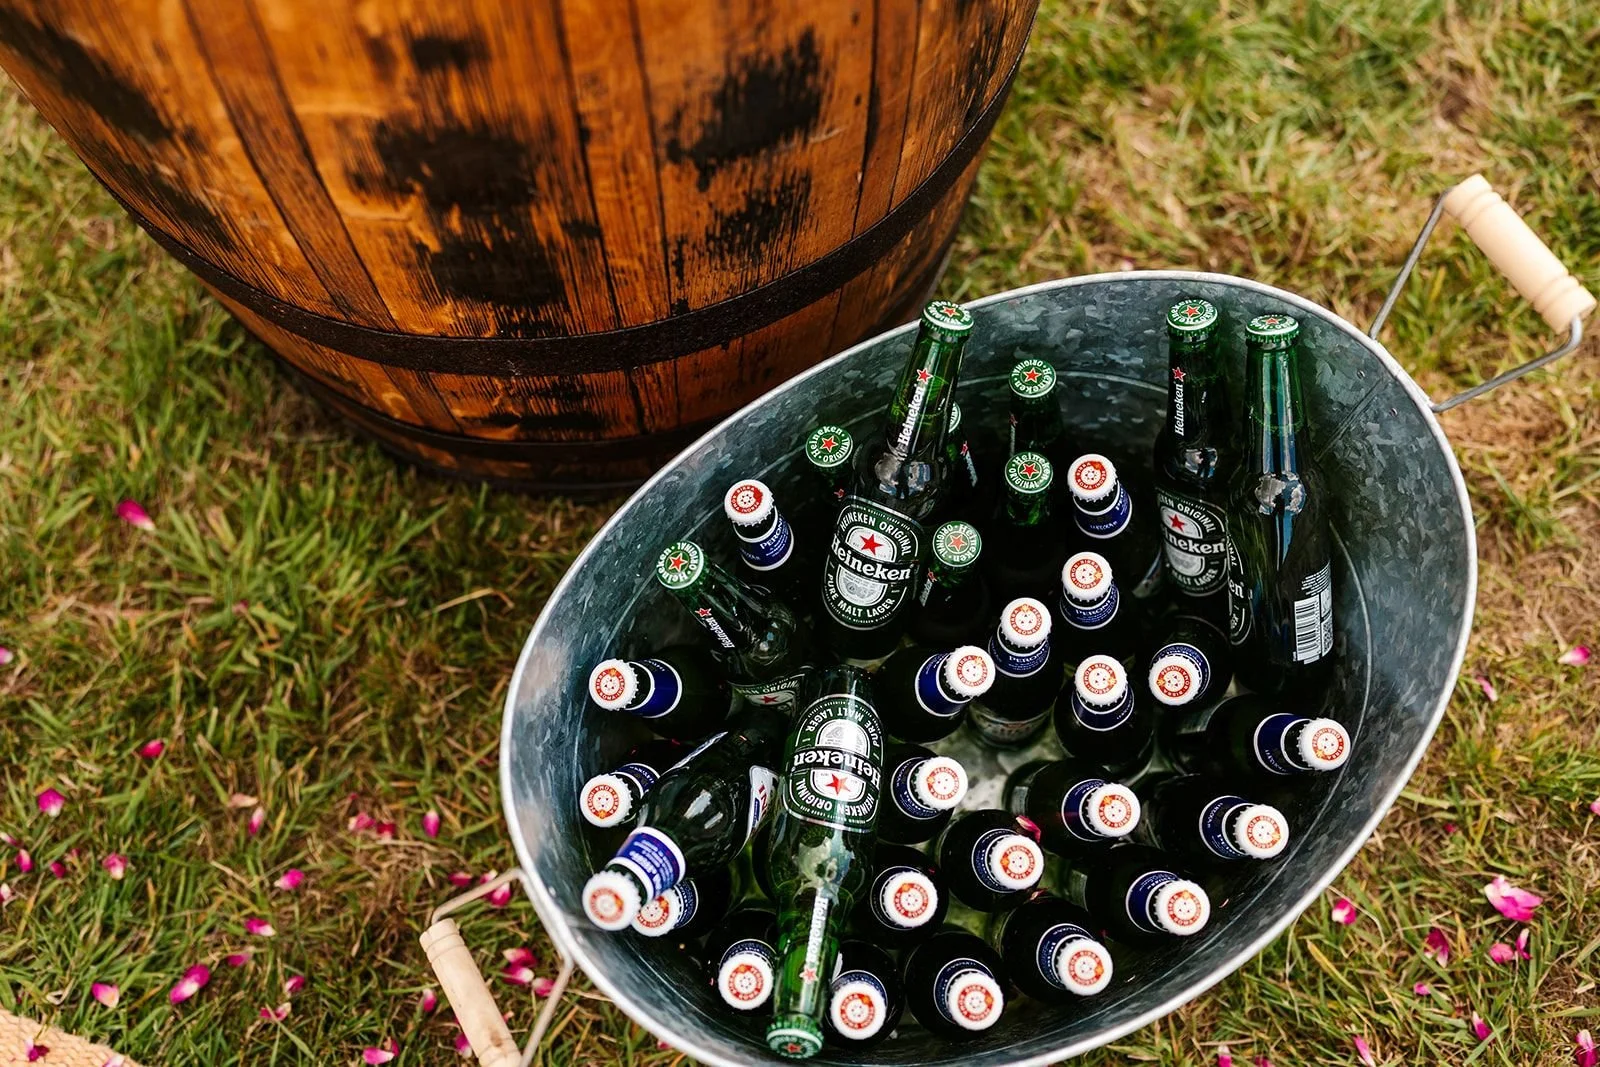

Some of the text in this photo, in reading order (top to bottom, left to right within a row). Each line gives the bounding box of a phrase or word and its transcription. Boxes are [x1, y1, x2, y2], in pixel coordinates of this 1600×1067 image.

[1011, 359, 1053, 394] ORIGINAL Heineken
[897, 386, 925, 447] Heineken
[1173, 383, 1185, 437] Heineken
[808, 425, 851, 463] Heineken ORIGINAL
[1008, 452, 1051, 489] Heineken ORIGINAL
[839, 511, 876, 532] HEINEKEN
[879, 521, 912, 556] ORIGINAL
[1177, 503, 1217, 533] ORIGINAL
[831, 533, 911, 581] Heineken
[935, 524, 977, 562] Heineken ORIGINAL
[656, 542, 699, 584] Heineken ORIGINAL
[827, 573, 840, 601] PURE
[837, 600, 863, 618] MALT
[866, 598, 896, 618] LAGER
[805, 708, 833, 732] LAGER
[837, 706, 864, 723] MALT
[863, 720, 880, 748] PURE
[793, 750, 882, 791] Heineken
[795, 778, 833, 811] ORIGINAL
[837, 792, 875, 818] HEINEKEN
